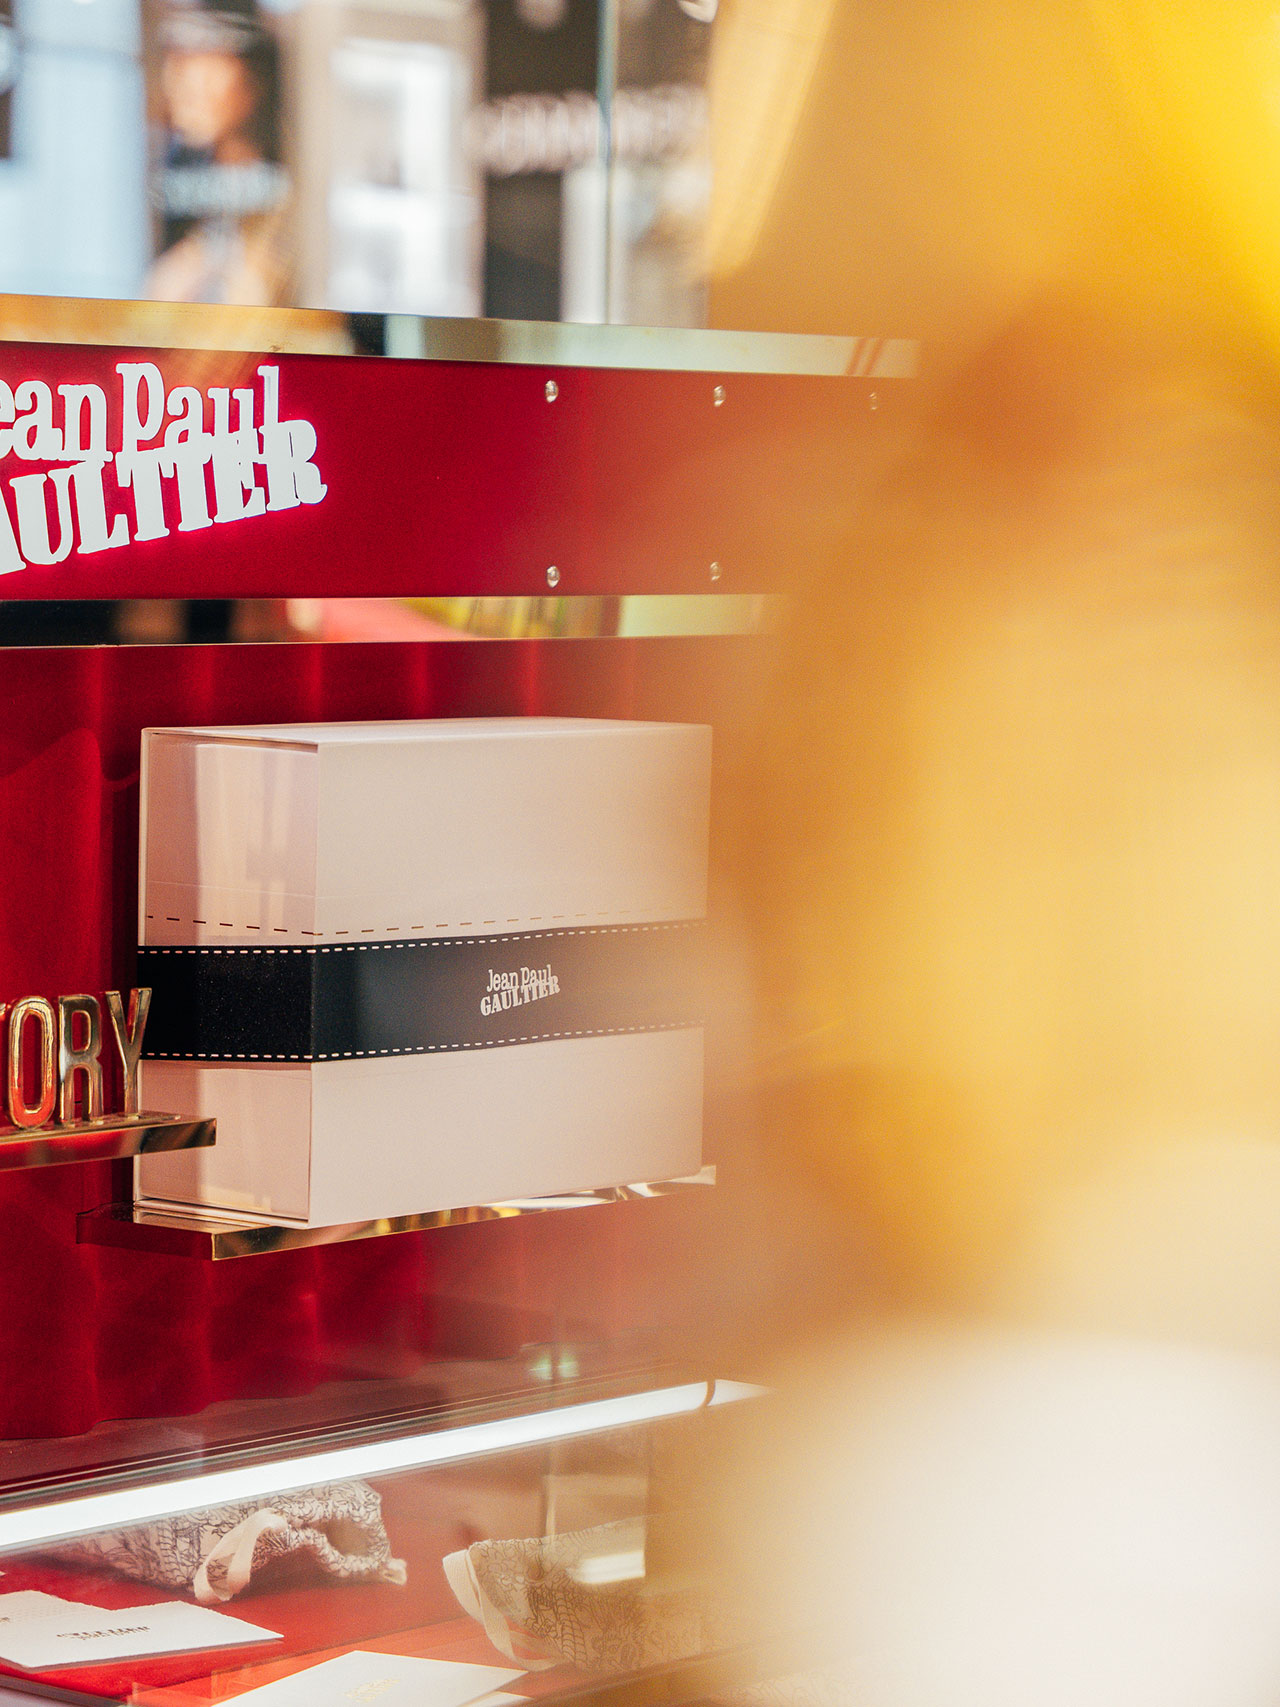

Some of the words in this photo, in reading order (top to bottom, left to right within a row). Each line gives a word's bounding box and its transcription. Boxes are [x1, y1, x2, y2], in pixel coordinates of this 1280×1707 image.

[116, 362, 280, 460] Paul
[480, 975, 560, 1016] GAULTIER
[486, 969, 519, 992] Jean
[520, 964, 552, 988] Paul
